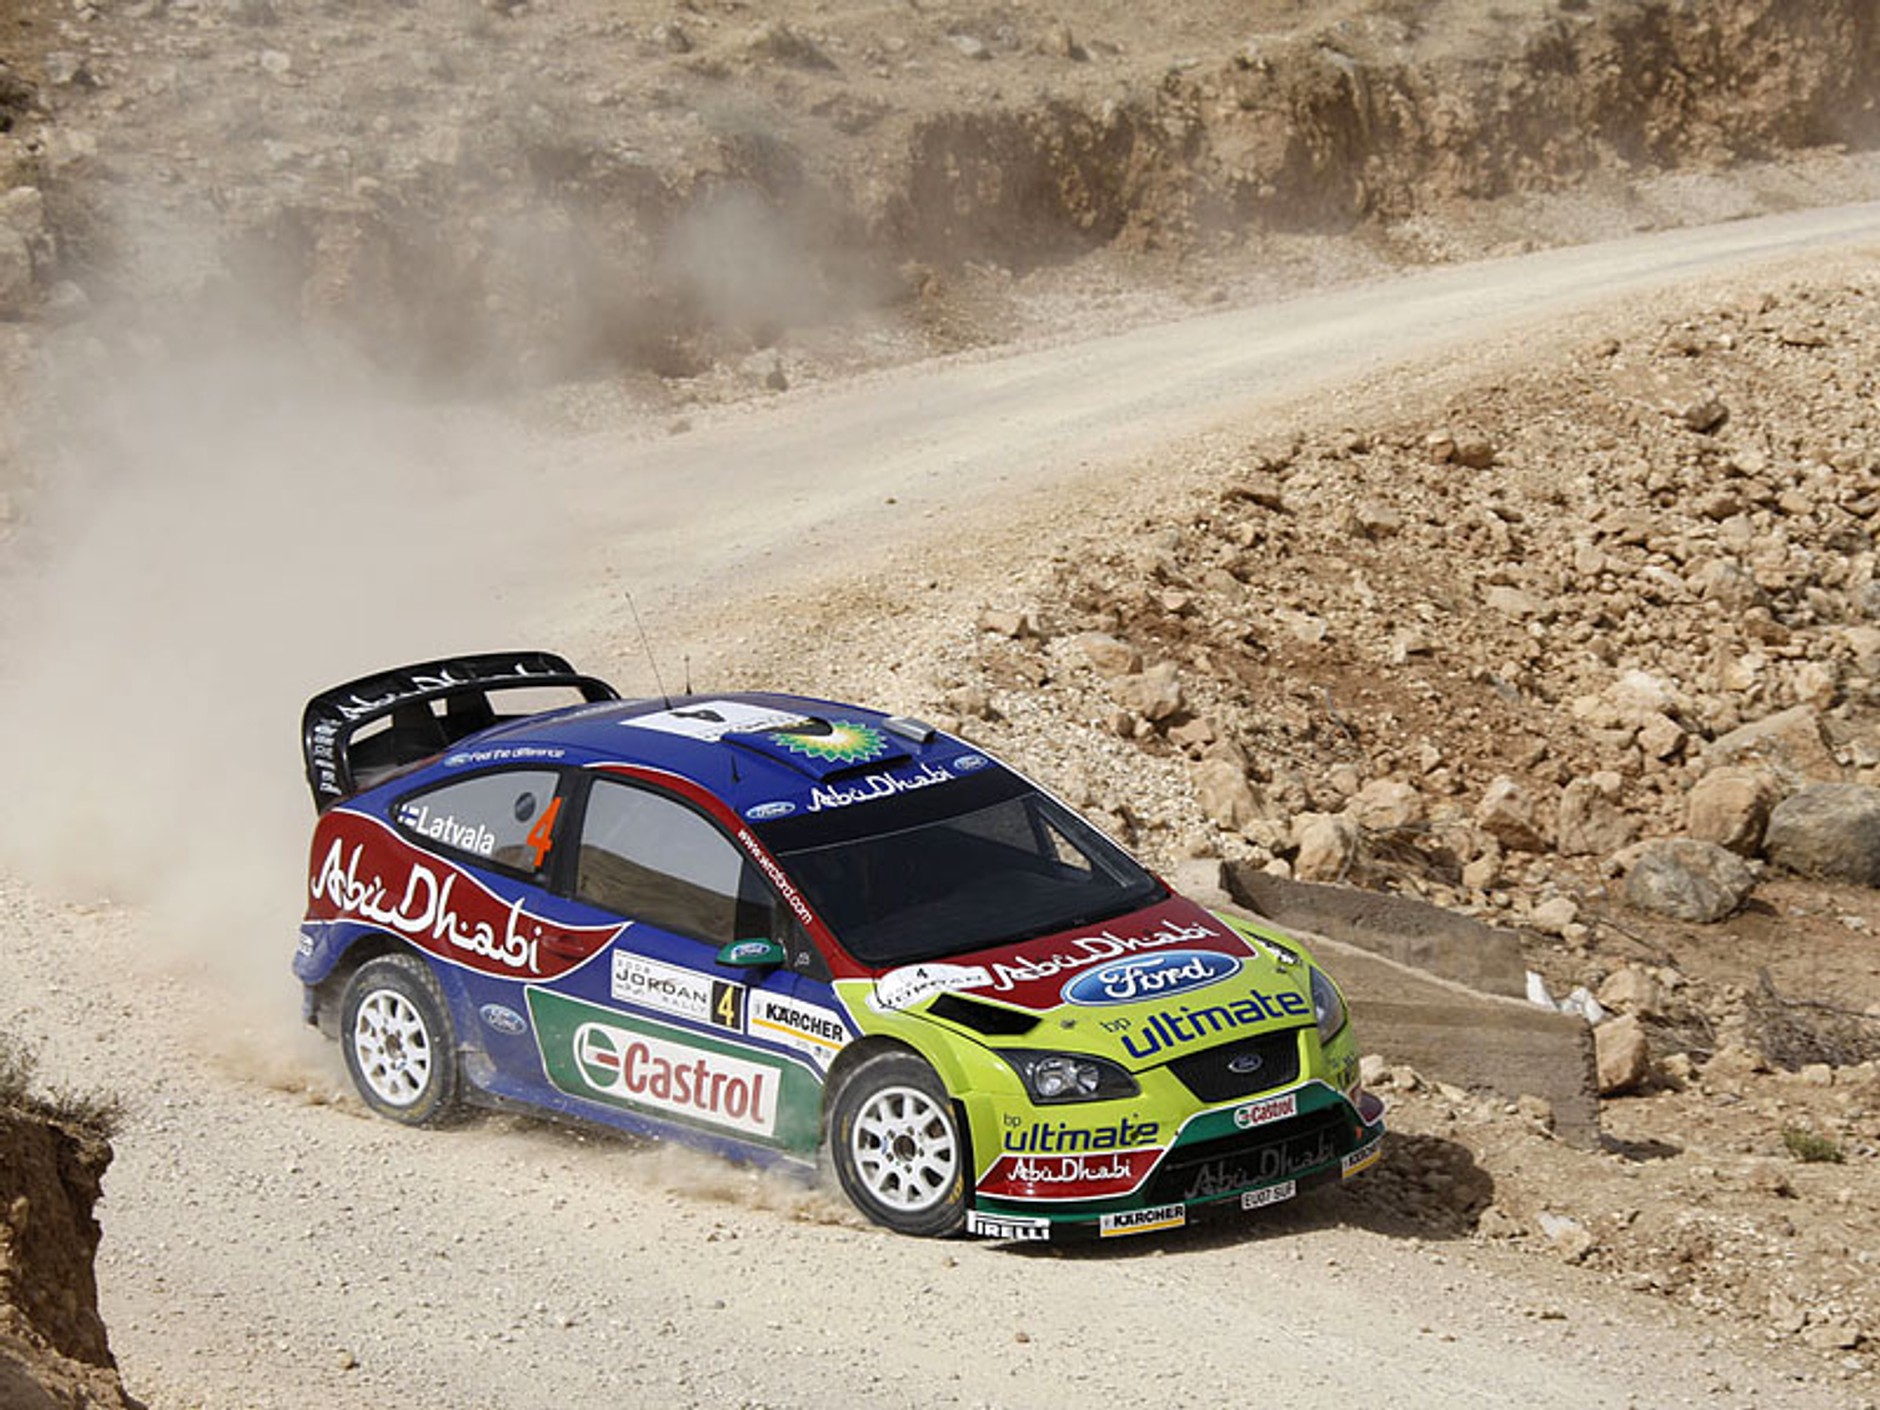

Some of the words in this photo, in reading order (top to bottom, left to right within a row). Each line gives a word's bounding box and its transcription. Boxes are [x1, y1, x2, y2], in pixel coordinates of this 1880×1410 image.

[865, 763, 956, 799] Dhabi
[417, 806, 496, 856] Latvala
[526, 796, 562, 867] 4
[737, 828, 814, 925] www.wrcford.com
[398, 863, 542, 974] Dhabi
[1071, 919, 1221, 960] Dhabi
[615, 969, 707, 1005] JORDAN
[1098, 956, 1215, 998] Ford
[717, 985, 736, 1027] 4
[1100, 1017, 1132, 1035] bp
[1120, 988, 1310, 1059] ultimate
[623, 1041, 766, 1125] Castrol
[1003, 1113, 1022, 1128] bp
[1003, 1118, 1160, 1151] ultimate
[1056, 1153, 1132, 1181] Dhabi
[966, 1209, 1050, 1240] PIRELLI
